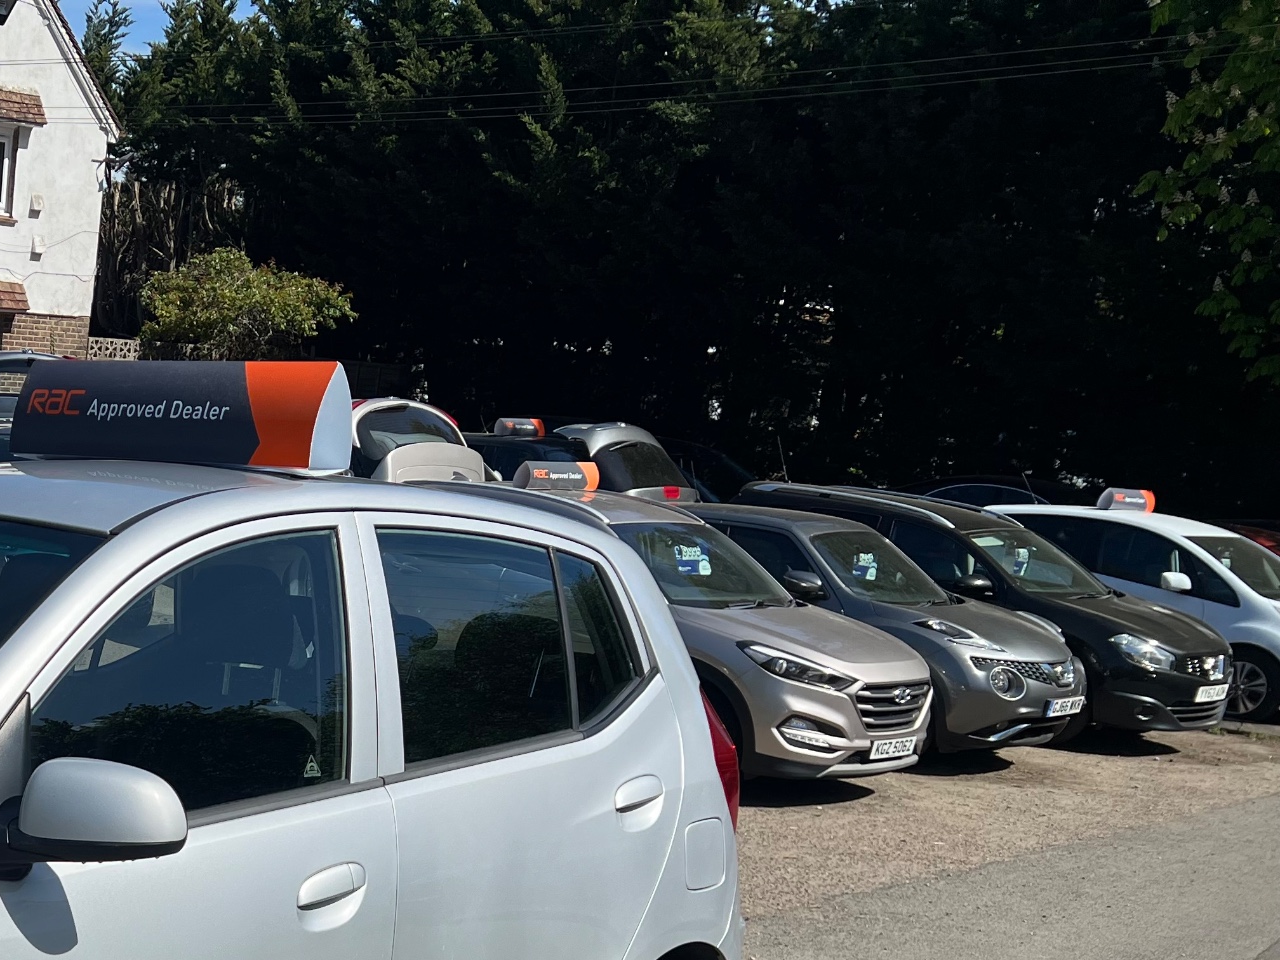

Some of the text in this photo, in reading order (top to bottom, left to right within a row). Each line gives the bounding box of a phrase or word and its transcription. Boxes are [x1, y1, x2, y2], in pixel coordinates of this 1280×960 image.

[87, 399, 164, 421] Approved
[170, 401, 230, 421] Dealer
[874, 739, 913, 756] KGZ 5062
